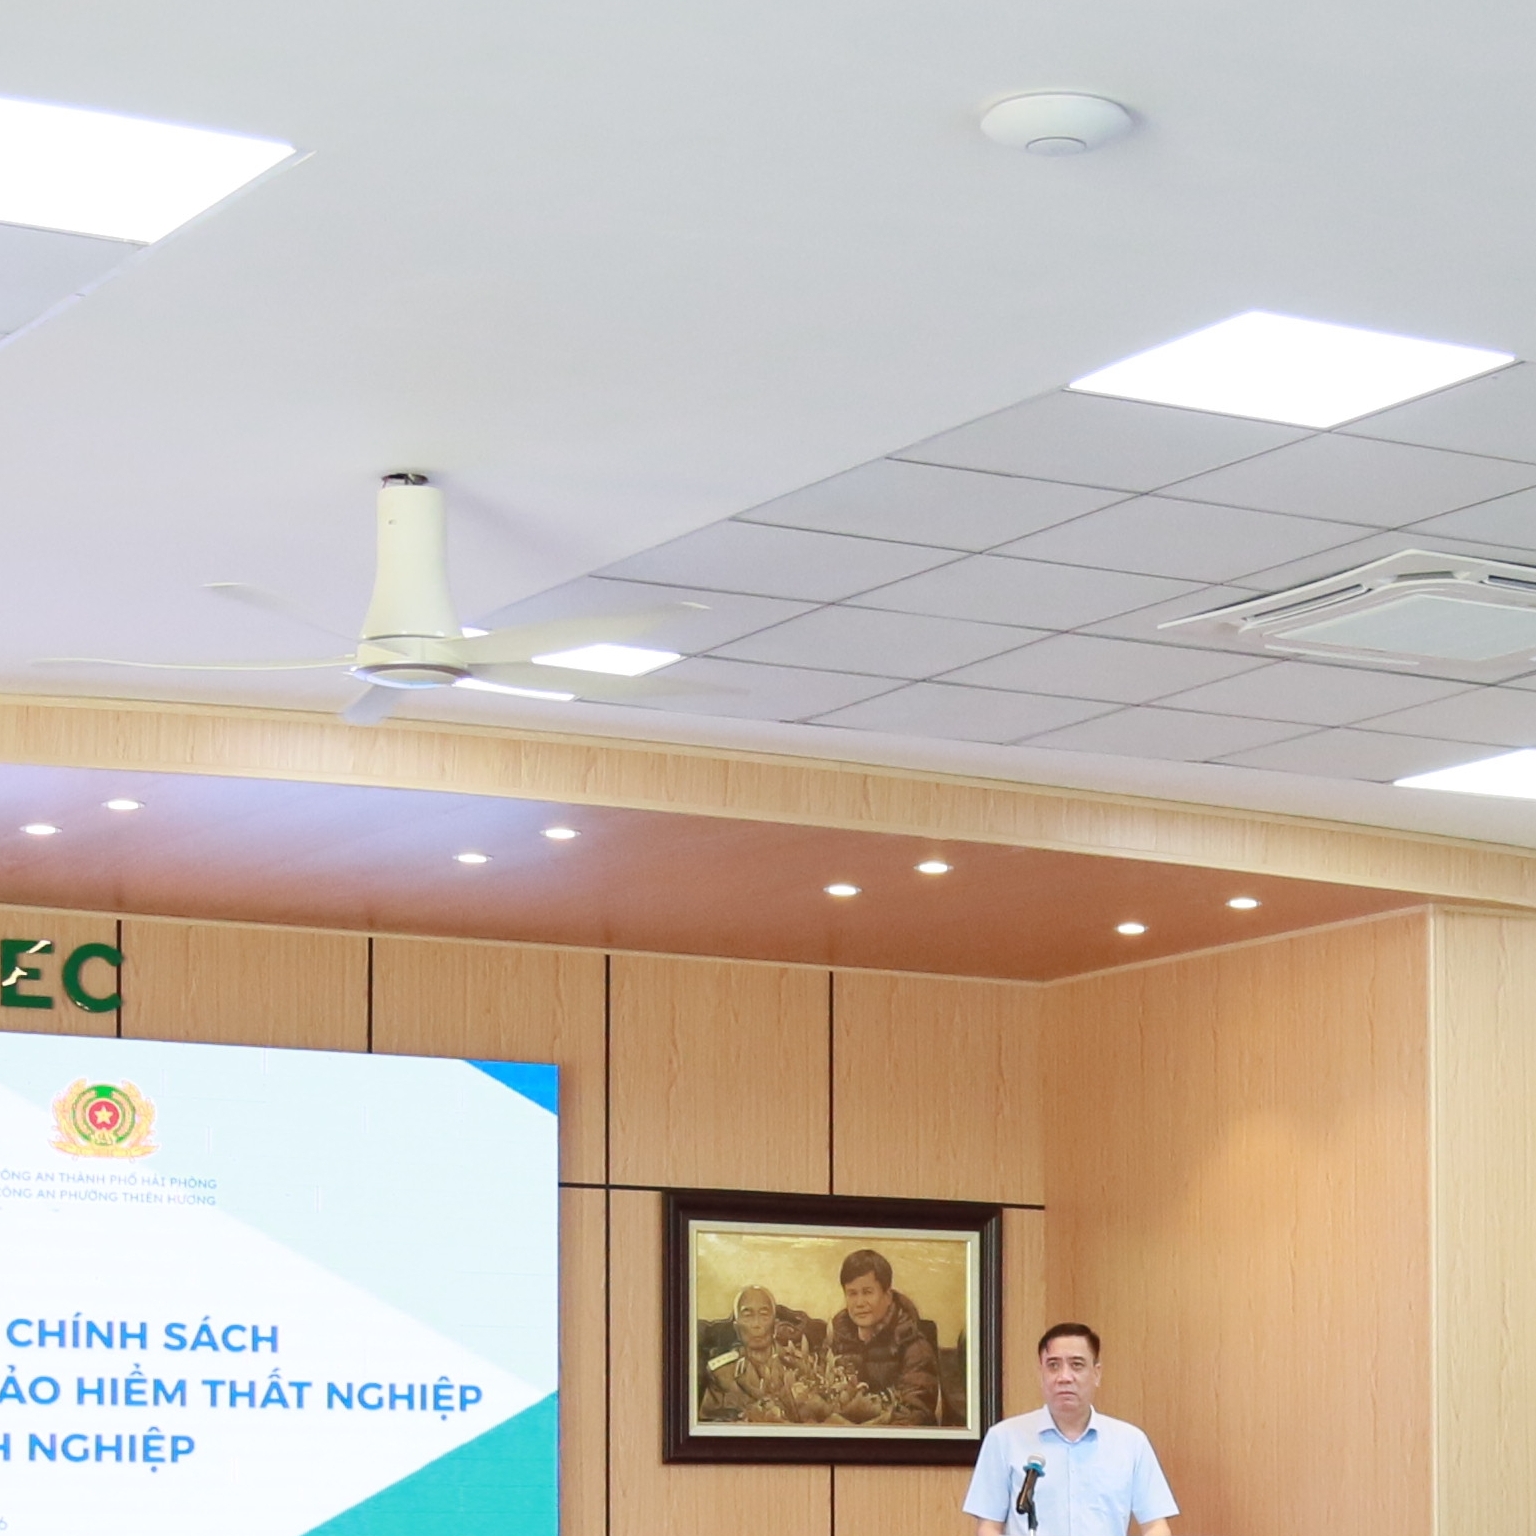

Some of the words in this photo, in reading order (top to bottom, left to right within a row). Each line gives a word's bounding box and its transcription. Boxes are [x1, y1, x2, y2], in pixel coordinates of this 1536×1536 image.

[35, 1171, 55, 1182] AN
[36, 1189, 56, 1199] AN
[6, 1311, 148, 1351] CHÍNH
[162, 1315, 279, 1354] SÁCH
[76, 1362, 187, 1408] HIỂM
[201, 1367, 312, 1410] THẤT
[326, 1375, 483, 1421] NGHIỆP
[28, 1426, 195, 1473] NGHIỆP
